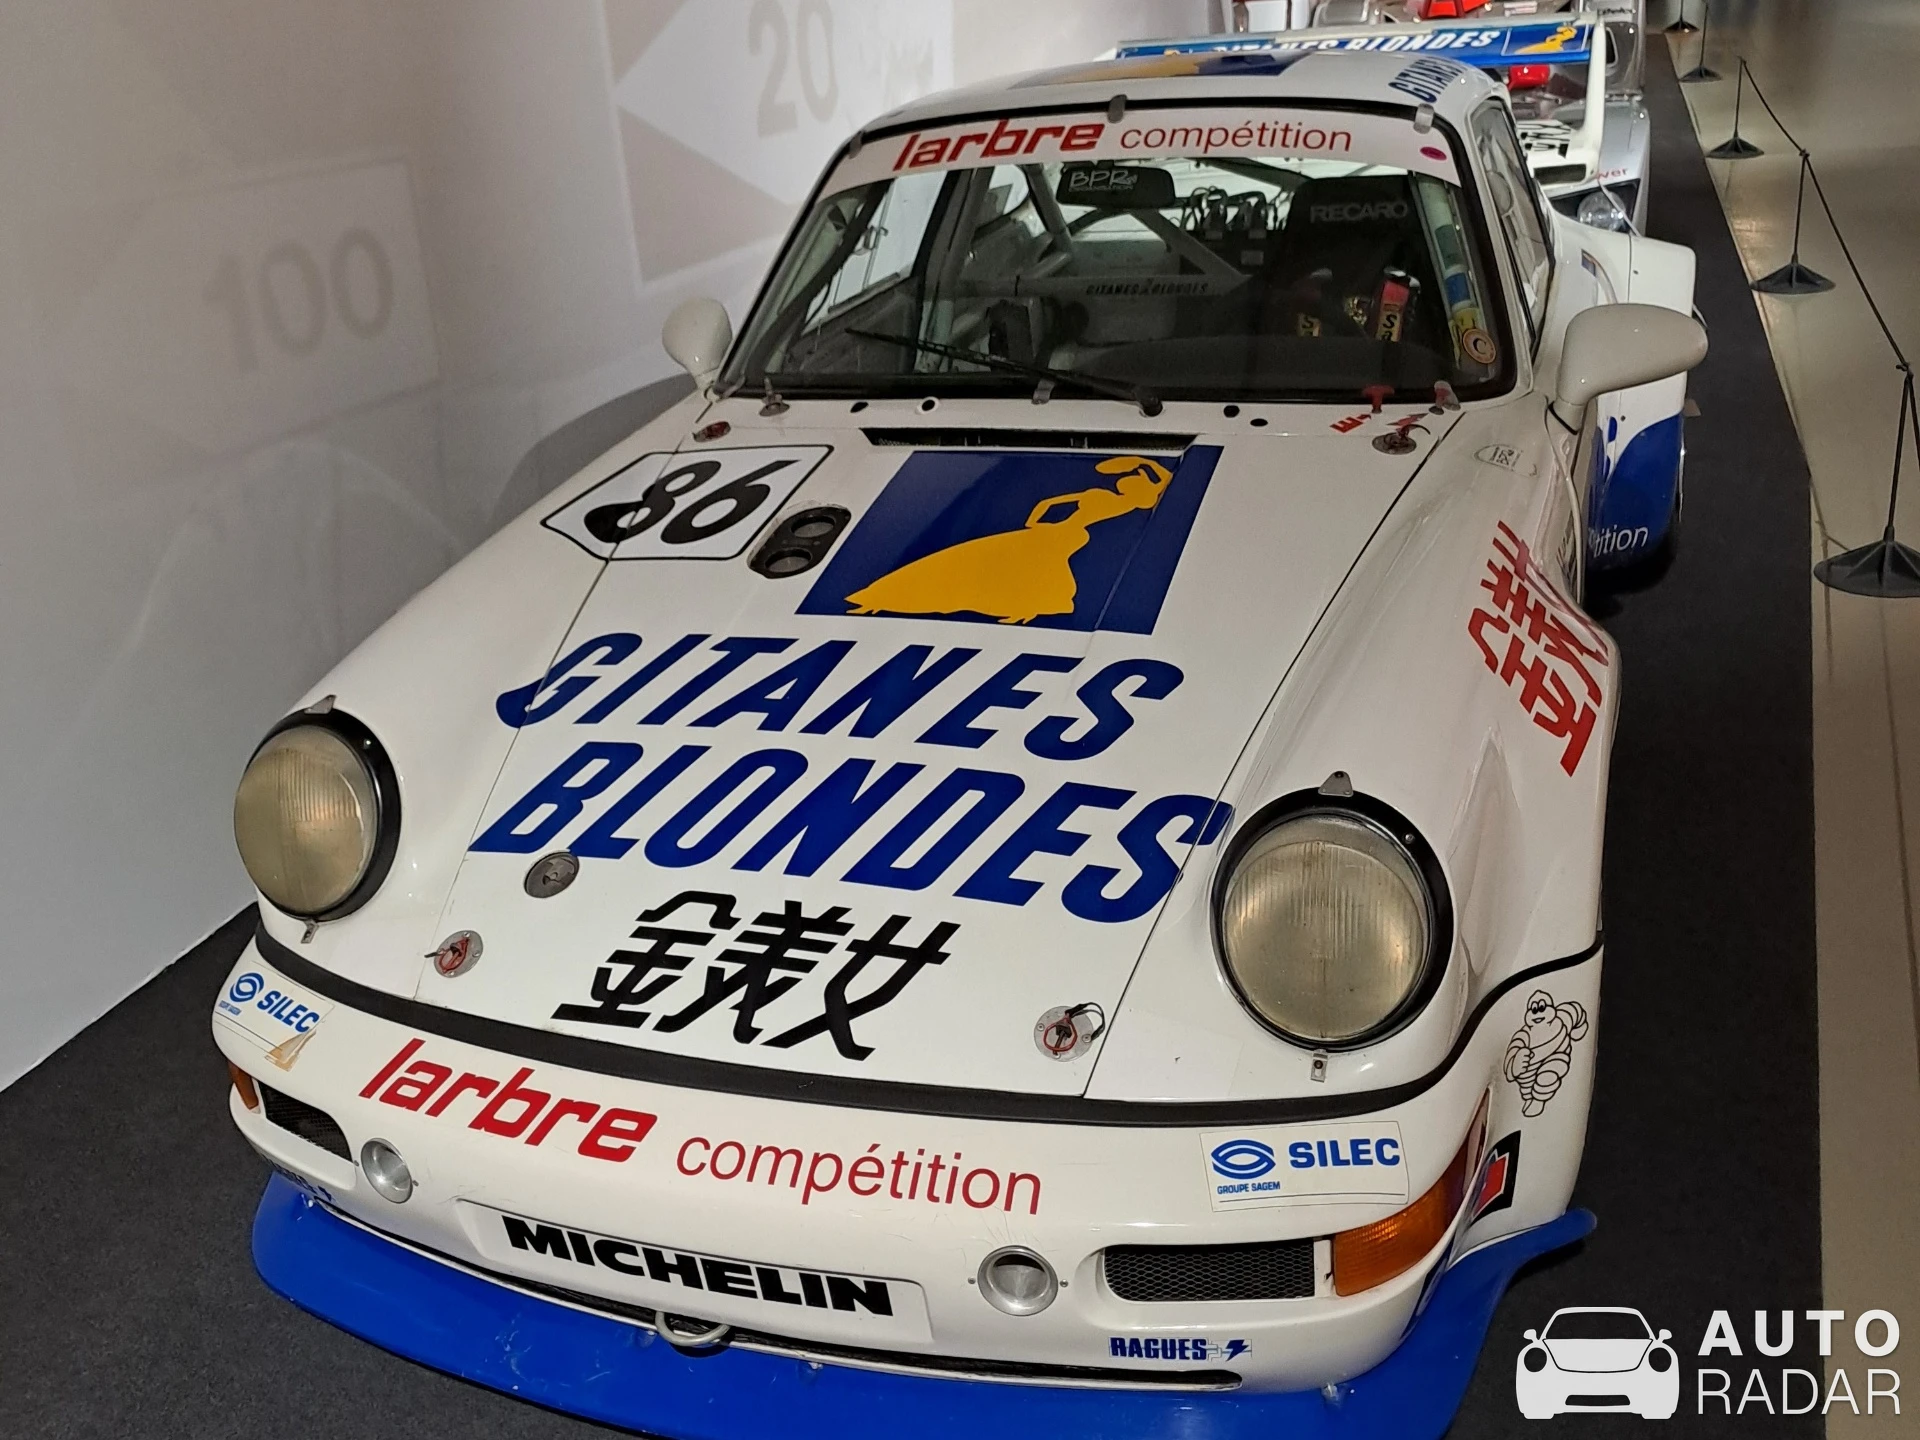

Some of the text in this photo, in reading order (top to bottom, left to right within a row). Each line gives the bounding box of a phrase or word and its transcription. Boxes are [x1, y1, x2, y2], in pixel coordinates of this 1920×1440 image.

[893, 119, 1351, 171] larbre compétition
[1310, 200, 1408, 224] RECARO
[201, 226, 394, 373] 100
[584, 459, 800, 545] 86
[495, 631, 1184, 761] GITANES
[468, 741, 1235, 923] BLONDES
[256, 990, 320, 1033] SILEC
[358, 1037, 1042, 1216] larbre compétition
[1288, 1137, 1401, 1169] SILEC
[1216, 1180, 1281, 1195] GROUPE SAGEM
[501, 1214, 894, 1317] MICHELIN
[1110, 1336, 1208, 1361] RAGUES
